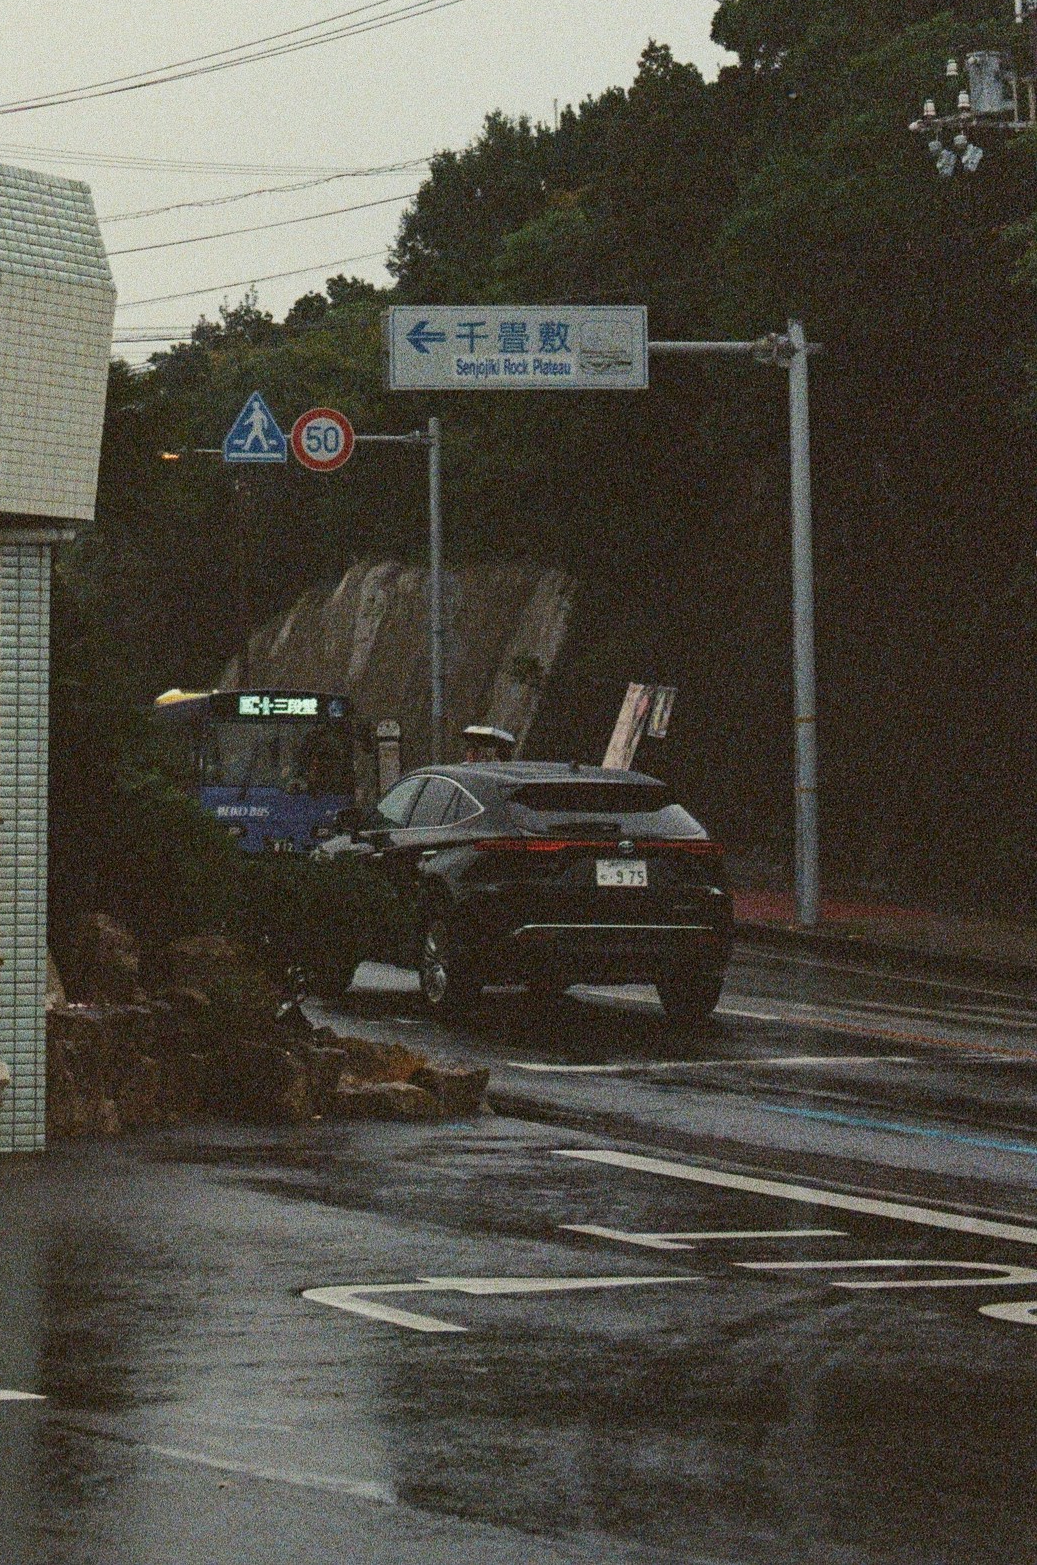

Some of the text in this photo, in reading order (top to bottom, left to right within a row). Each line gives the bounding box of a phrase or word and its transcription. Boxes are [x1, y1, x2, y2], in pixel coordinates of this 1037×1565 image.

[455, 321, 572, 354] 千畳敷
[456, 358, 571, 378] Senjojiki Rock Plateau
[306, 426, 339, 453] 50
